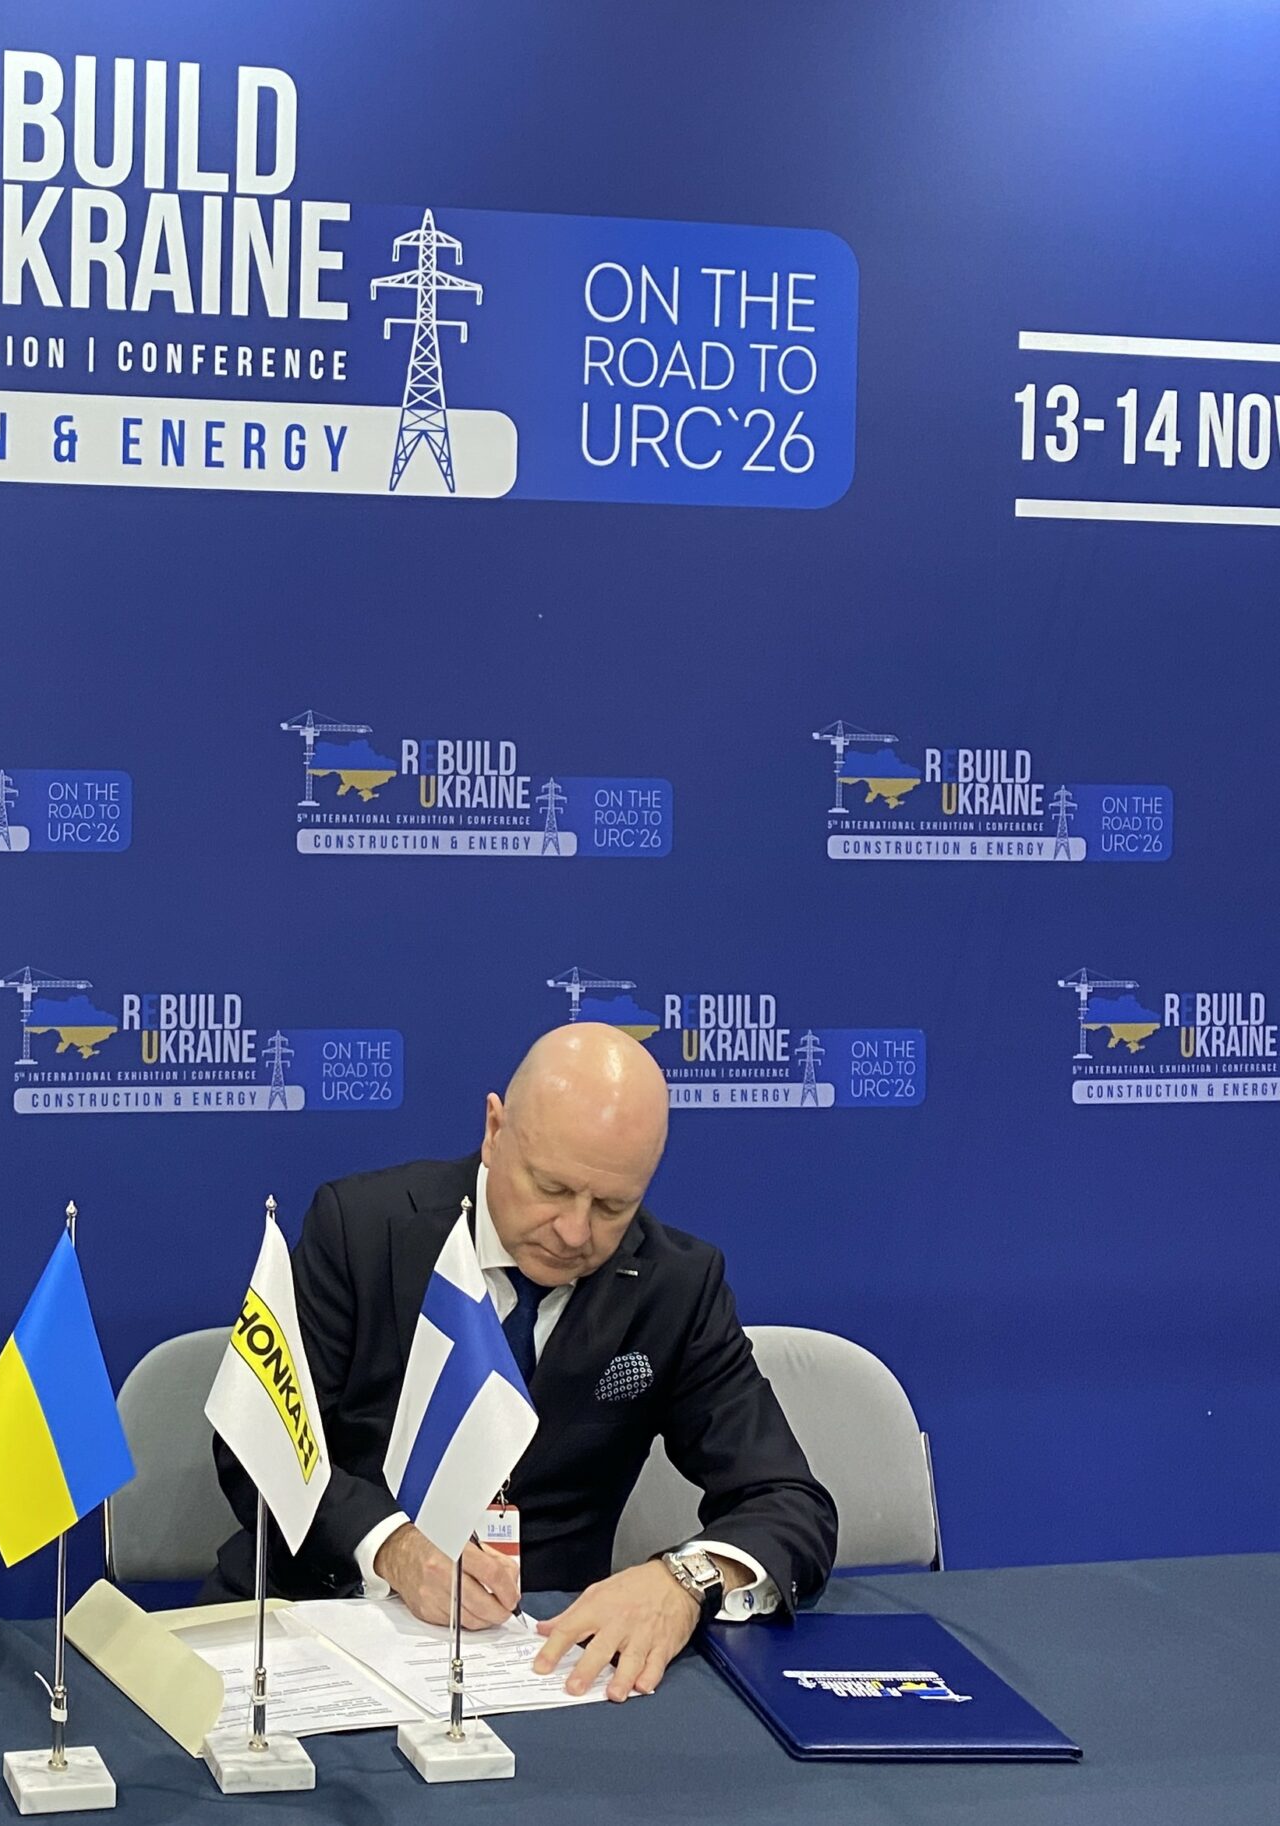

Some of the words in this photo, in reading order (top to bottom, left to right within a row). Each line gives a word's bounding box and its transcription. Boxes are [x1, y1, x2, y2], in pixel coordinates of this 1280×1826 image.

[585, 262, 679, 325] ON
[701, 268, 816, 332] THE
[118, 341, 346, 380] CONFERENCE
[584, 336, 735, 390] ROAD
[750, 344, 817, 395] TO
[1015, 384, 1181, 466] 13-14
[1198, 392, 1280, 470] NO
[54, 415, 78, 463] &
[122, 417, 347, 472] ENERGY
[402, 739, 516, 776] REBUILD
[925, 748, 1031, 783] REBUILD
[48, 782, 78, 800] ON
[83, 782, 119, 801] THE
[420, 775, 531, 809] UKRAINE
[595, 789, 622, 807] ON
[627, 790, 661, 808] THE
[942, 783, 1044, 815] UKRAINE
[48, 803, 95, 819] ROAD
[99, 804, 120, 819] TO
[1102, 797, 1127, 814] ON
[1132, 796, 1162, 814] THE
[311, 813, 390, 824] INTERNATIONAL
[396, 814, 454, 824] EXHIBITION
[467, 815, 530, 825] CONFERENCE
[595, 810, 638, 825] ROAD
[641, 810, 662, 826] TO
[841, 820, 915, 830] INTERNATIONAL
[920, 821, 974, 830] EXHIBITION
[986, 822, 1043, 831] CONFERENCE
[1102, 816, 1142, 831] ROAD
[1145, 816, 1163, 831] TO
[314, 834, 439, 849] CONSTRUCTION
[450, 836, 458, 849] &
[469, 836, 530, 850] ENERGY
[843, 840, 960, 855] CONSTRUCTION
[970, 841, 977, 855] &
[987, 842, 1044, 856] ENERGY
[123, 994, 241, 1030] REBUILD
[665, 994, 776, 1029] REBUILD
[1165, 992, 1265, 1027] REBUILD
[142, 1030, 257, 1064] UKRAINE
[323, 1041, 351, 1060] ON
[356, 1041, 391, 1060] THE
[683, 1029, 790, 1062] UKRAINE
[851, 1041, 878, 1058] ON
[883, 1040, 915, 1058] THE
[1181, 1025, 1278, 1058] UKRAINE
[28, 1072, 111, 1082] INTERNATIONAL
[117, 1071, 178, 1081] EXHIBITION
[191, 1070, 256, 1080] CONFERENCE
[323, 1062, 368, 1078] ROAD
[371, 1062, 392, 1077] TO
[729, 1068, 789, 1078] CONFERENCE
[851, 1060, 893, 1076] ROAD
[896, 1060, 916, 1075] TO
[1085, 1065, 1155, 1074] INTERNATIONAL
[1160, 1064, 1211, 1074] EXHIBITION
[1222, 1063, 1277, 1072] CONFERENCE
[32, 1092, 162, 1108] CONSTRUCTION
[174, 1092, 181, 1106] &
[192, 1091, 256, 1106] ENERGY
[713, 1089, 720, 1102] &
[730, 1088, 790, 1102] ENERGY
[1087, 1083, 1198, 1099] CONSTRUCTION
[1207, 1083, 1214, 1097] &
[1223, 1082, 1277, 1096] ENERGY
